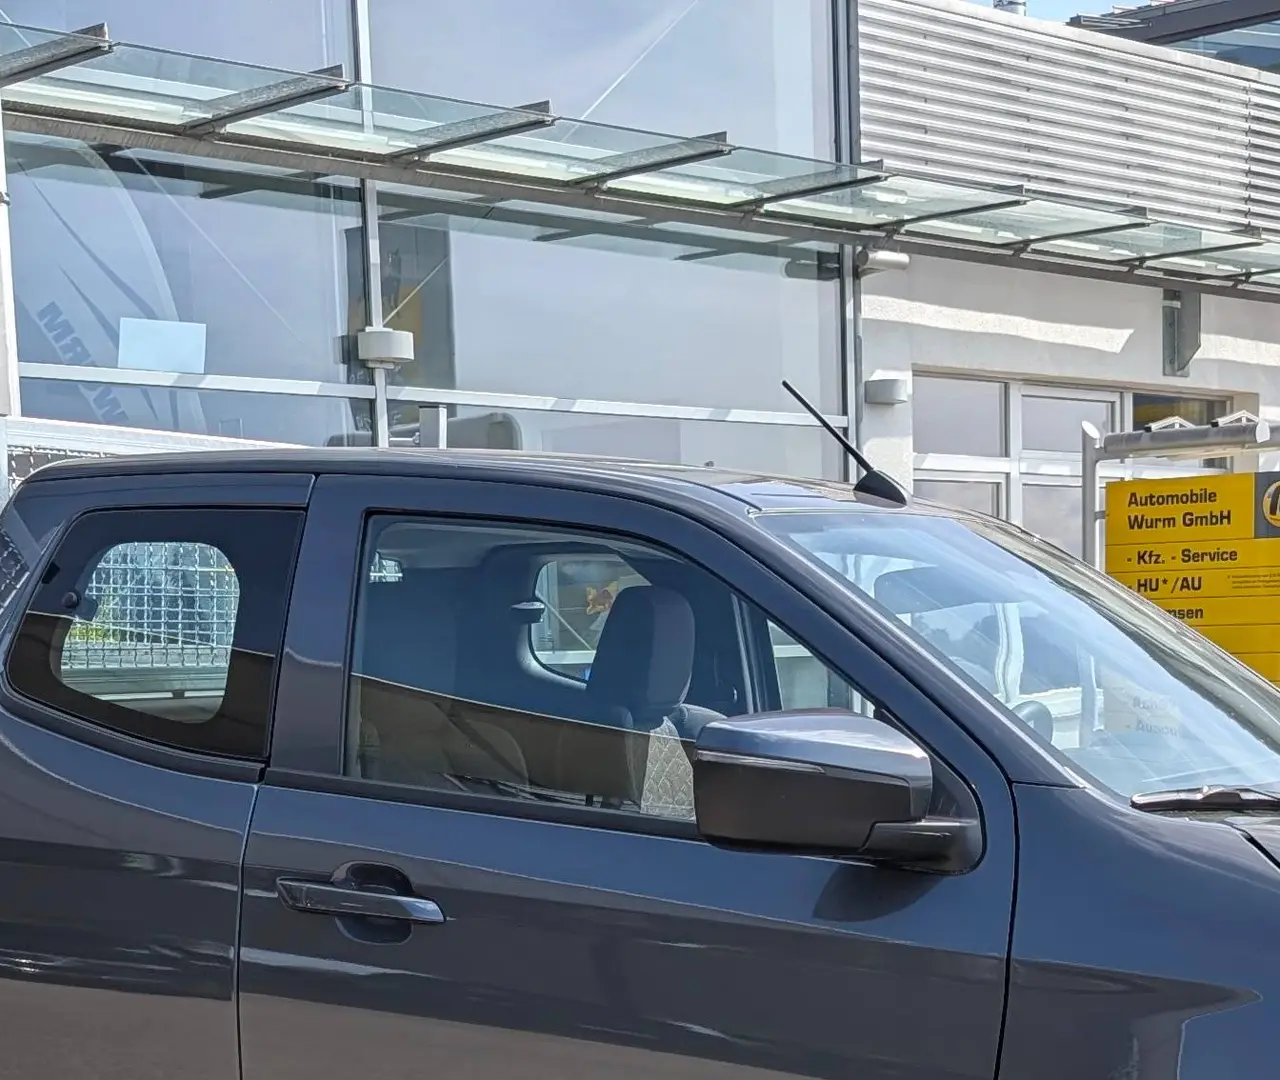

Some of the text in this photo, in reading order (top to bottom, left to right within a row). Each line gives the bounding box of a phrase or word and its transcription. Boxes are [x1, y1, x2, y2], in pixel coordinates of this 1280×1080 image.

[1127, 488, 1218, 507] Automobile
[1127, 510, 1232, 530] Wurm GmbH
[1137, 550, 1166, 565] Kfz.
[1181, 547, 1238, 563] Service
